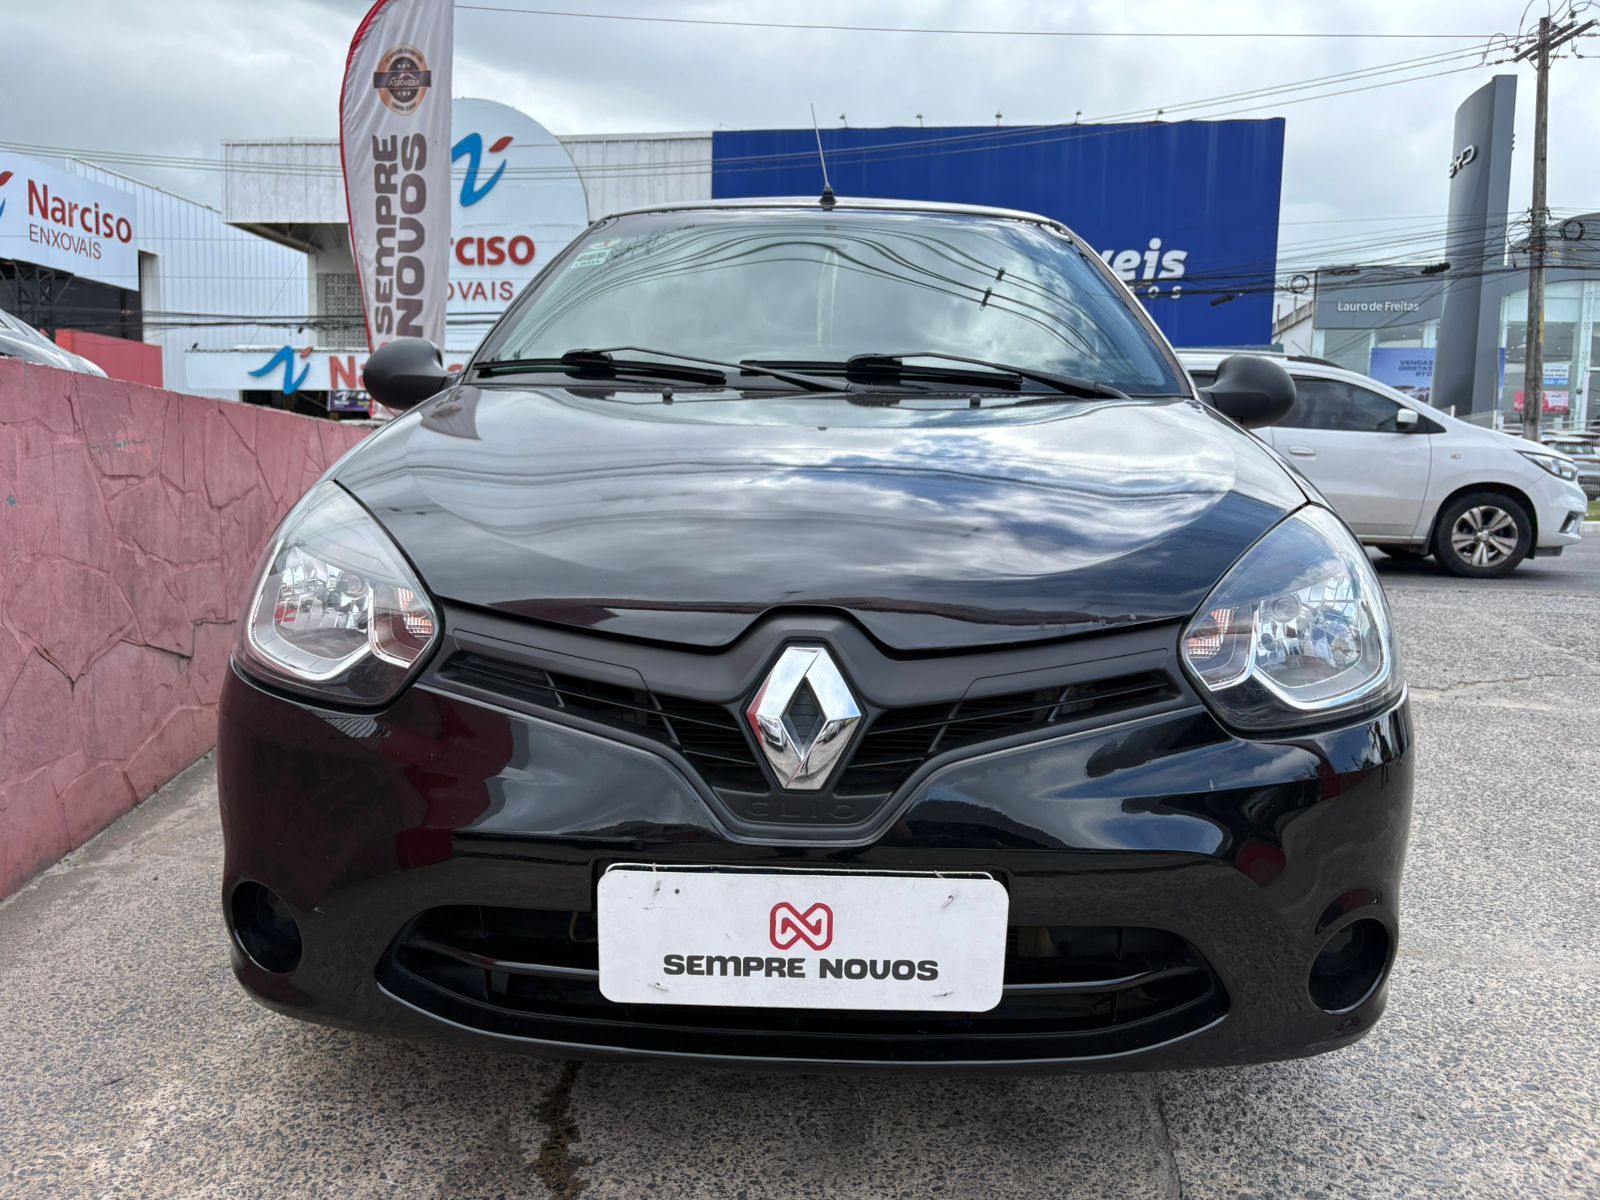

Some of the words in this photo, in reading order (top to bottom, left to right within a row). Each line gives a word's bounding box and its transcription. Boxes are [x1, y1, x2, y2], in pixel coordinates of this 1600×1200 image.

[28, 179, 132, 243] Narciso
[29, 223, 102, 260] ENXOVAIS
[372, 134, 398, 335] SEMPRE
[396, 133, 427, 338] NOVOS
[1337, 301, 1368, 312] Lauro
[1369, 301, 1382, 312] de
[1384, 301, 1419, 312] Freitas
[745, 802, 857, 820] CLIO
[663, 954, 806, 978] SEMPRE
[819, 958, 939, 981] NOVOS
